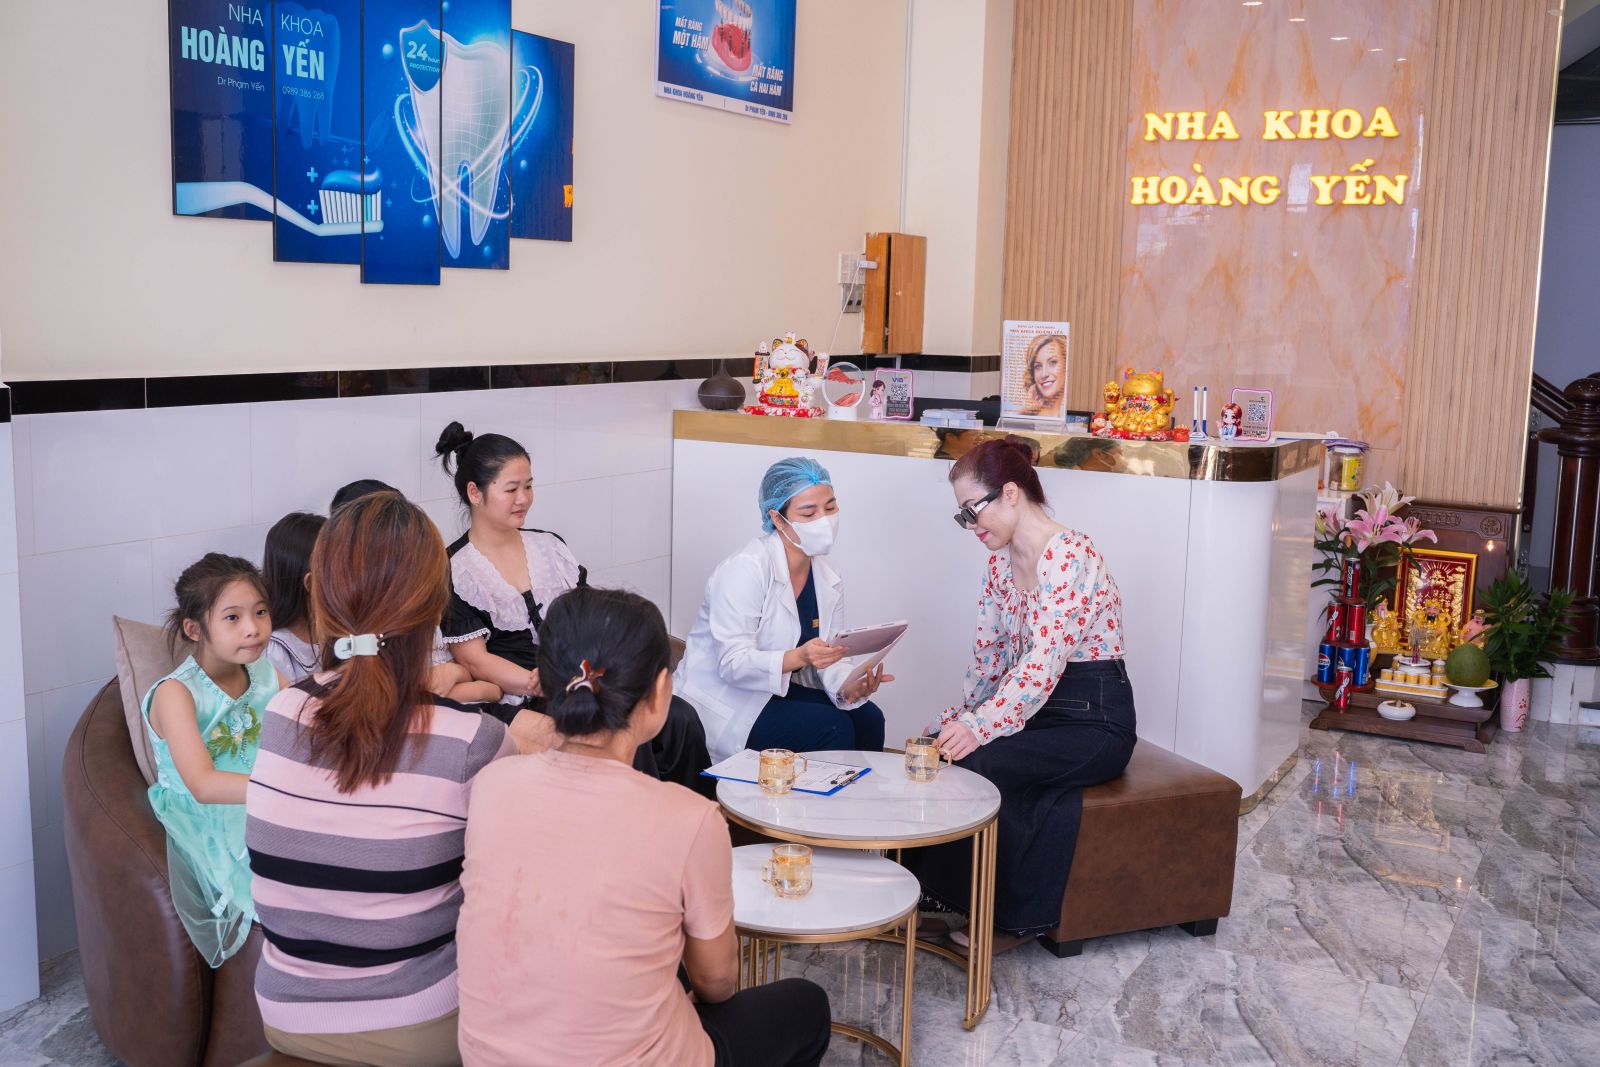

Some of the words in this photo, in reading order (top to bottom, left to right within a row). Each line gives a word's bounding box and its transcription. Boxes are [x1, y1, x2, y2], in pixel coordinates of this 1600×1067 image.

[228, 3, 264, 27] NHA
[281, 13, 324, 38] KHOA
[181, 25, 265, 72] HOÀNG
[282, 38, 325, 81] YẾN
[406, 40, 428, 61] 24
[673, 29, 691, 49] MỘT
[217, 76, 225, 85] Dr
[1144, 110, 1240, 141] NHA
[1262, 106, 1400, 140] KHOA
[1130, 162, 1281, 206] HOÀNG
[1310, 158, 1409, 206] YẾN
